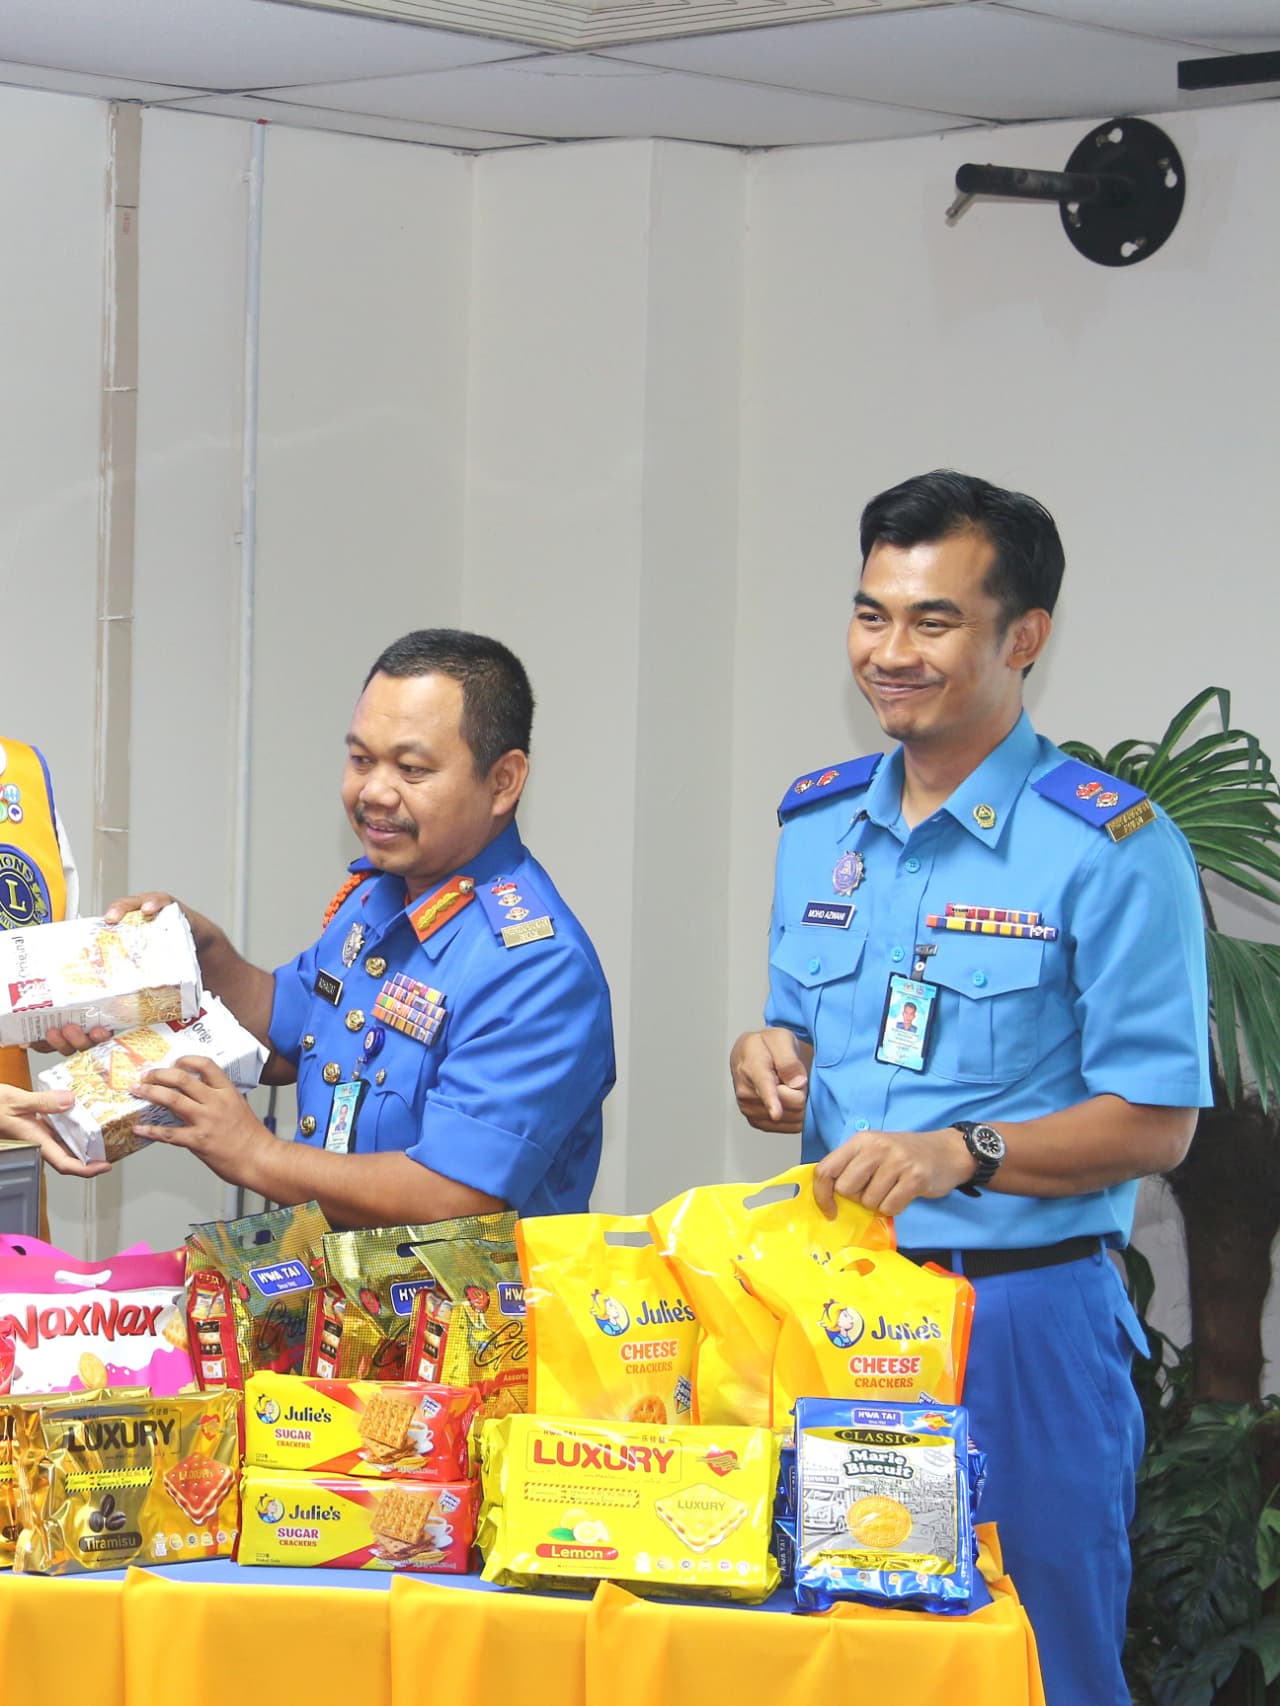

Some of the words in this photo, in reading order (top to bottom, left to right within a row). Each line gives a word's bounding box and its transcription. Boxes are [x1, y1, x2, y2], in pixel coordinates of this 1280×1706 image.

[5, 878, 27, 912] L
[257, 1268, 282, 1285] HWA
[282, 1264, 301, 1279] TAI
[505, 1287, 524, 1301] HW
[636, 1299, 696, 1326] Julie's
[4, 1298, 163, 1350] NaxNax
[620, 1340, 678, 1361] CHEESE
[625, 1361, 673, 1375] CRACKERS
[849, 1356, 920, 1374] CHEESE
[854, 1377, 914, 1388] CRACKERS
[284, 1406, 332, 1423] Julie's
[858, 1410, 880, 1420] HWA
[881, 1411, 897, 1421] TAI
[67, 1418, 176, 1452] LUXURY
[275, 1429, 312, 1441] SUGAR
[841, 1430, 915, 1444] CLASSIC
[276, 1441, 311, 1449] CRACKERS
[534, 1439, 675, 1474] LUXURY
[851, 1449, 906, 1465] Marie
[846, 1462, 913, 1479] Biscuit
[289, 1504, 341, 1521] Julie's
[677, 1500, 726, 1512] LUXURY
[277, 1527, 319, 1539] SUGAR
[84, 1534, 138, 1550] Tiramisu
[279, 1539, 318, 1547] CRACKERS
[551, 1545, 604, 1559] Lemon
